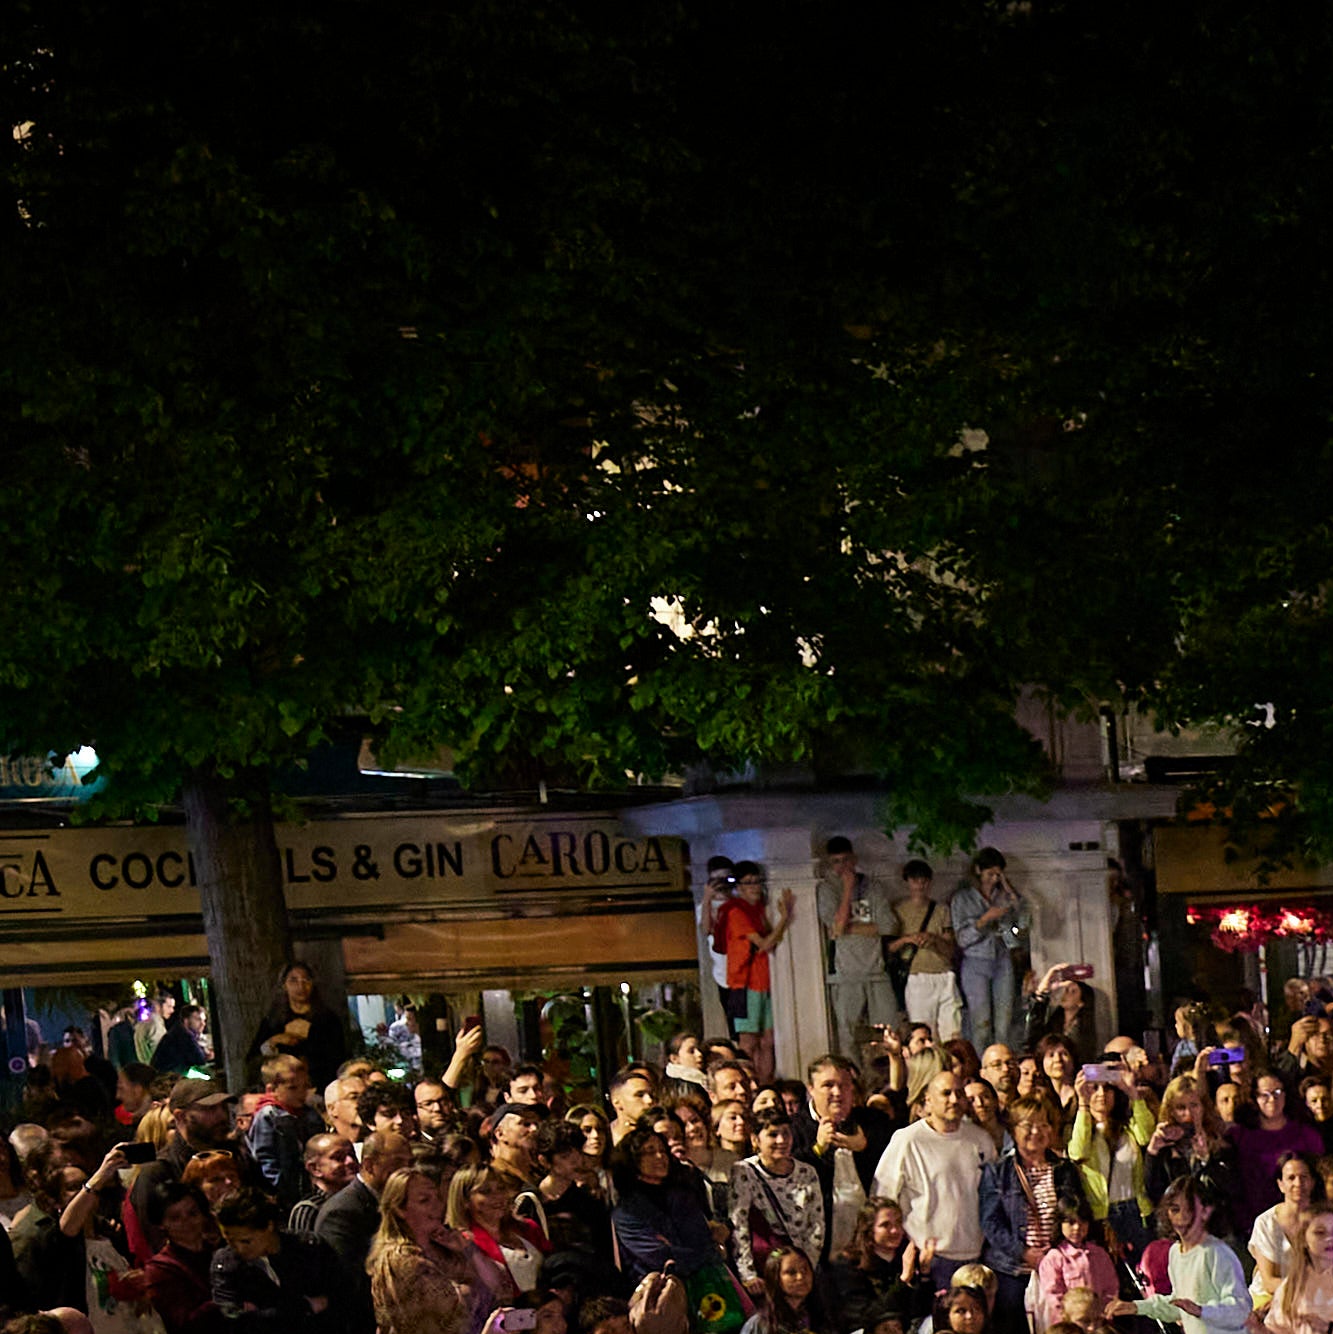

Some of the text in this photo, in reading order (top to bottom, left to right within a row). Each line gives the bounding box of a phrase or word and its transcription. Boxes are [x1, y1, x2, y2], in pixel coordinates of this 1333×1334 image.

[351, 844, 381, 881] &
[393, 841, 464, 879] GIN
[490, 829, 670, 880] CAROCA
